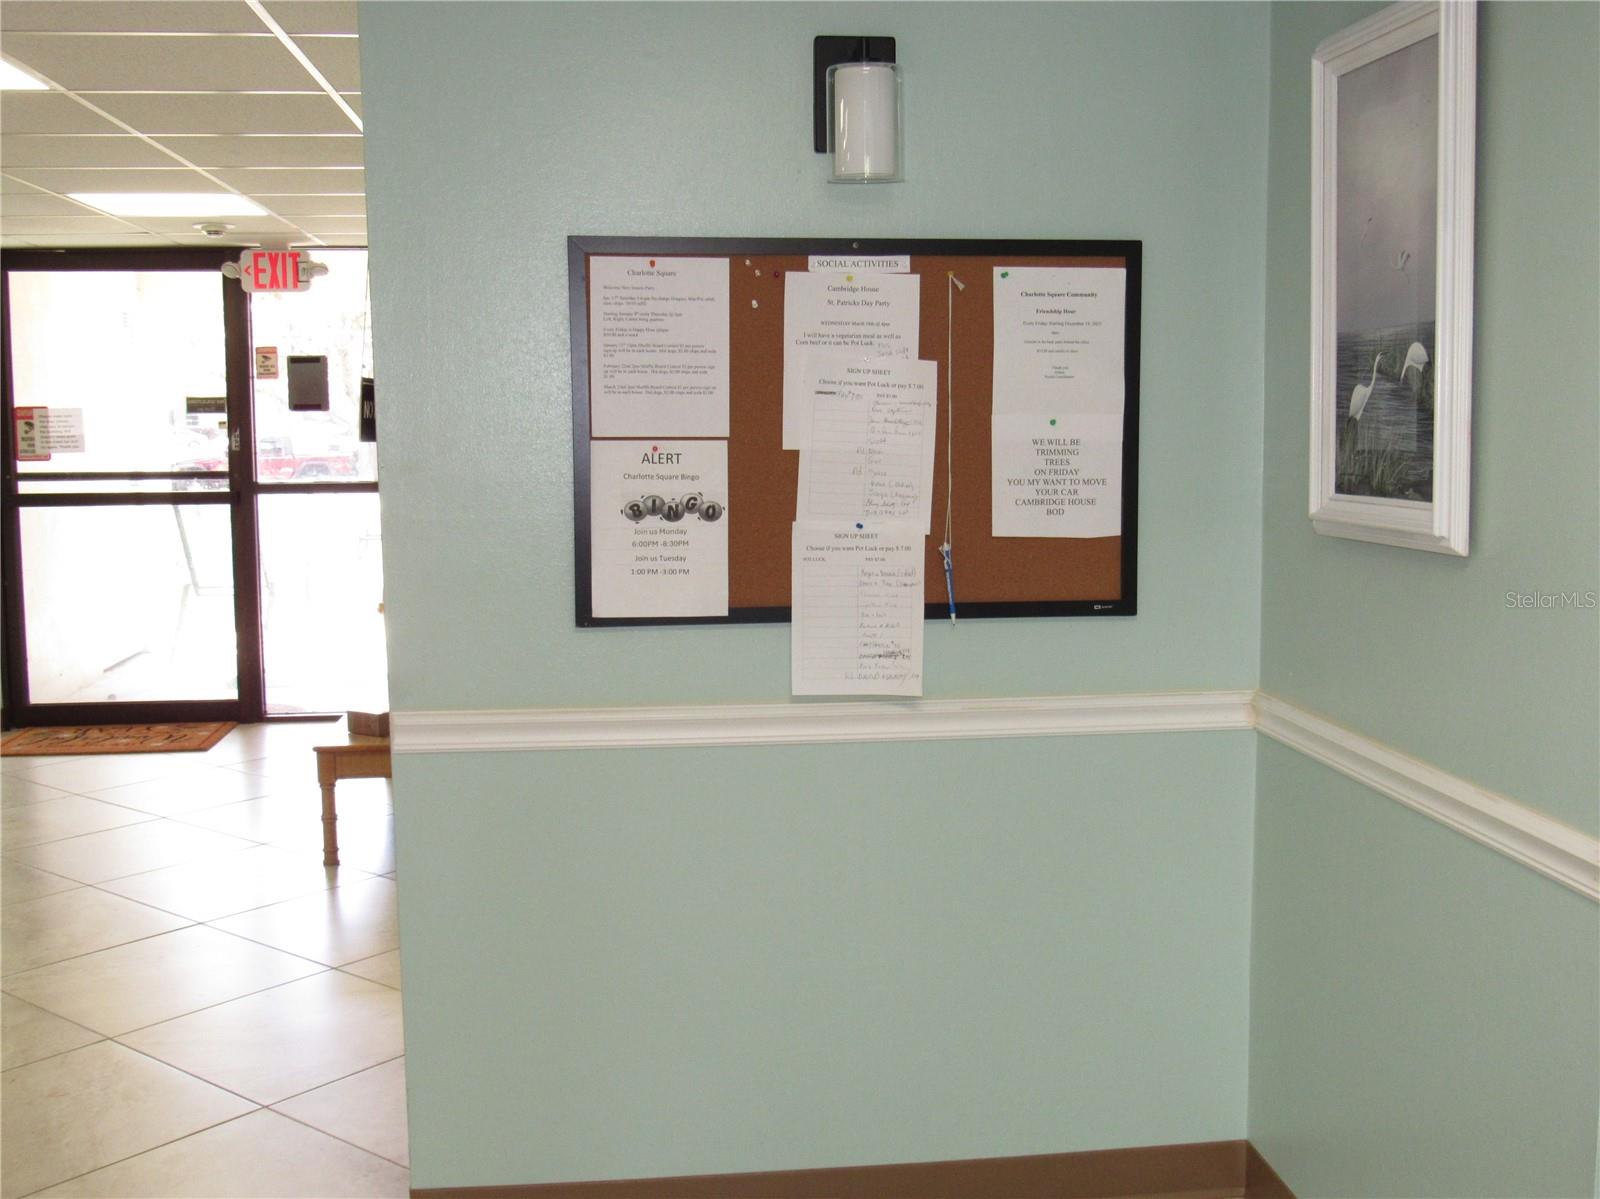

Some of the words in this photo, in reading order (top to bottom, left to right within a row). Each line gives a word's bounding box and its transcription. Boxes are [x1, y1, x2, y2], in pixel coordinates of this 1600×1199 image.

[817, 260, 848, 268] SOCIAL
[850, 260, 899, 268] ACTIVITIES
[253, 252, 301, 289] EXIT
[627, 269, 656, 277] Charlotte
[656, 269, 677, 277] Square
[827, 285, 859, 293] Cambridge
[1032, 438, 1045, 446] WE
[1047, 438, 1068, 446] WILL
[1069, 438, 1081, 446] BE
[1036, 448, 1080, 456] TRIMMING
[641, 452, 682, 465] ALERT
[1044, 458, 1071, 466] TREES
[1034, 468, 1047, 476] ON
[1048, 468, 1080, 476] FRIDAY
[656, 473, 679, 481] Square
[680, 473, 700, 481] Bingo
[1035, 488, 1059, 496] YOUR
[1060, 488, 1080, 496] CAR
[1015, 498, 1066, 506] CAMBRIDGE
[1067, 498, 1097, 506] HOUSE
[628, 496, 716, 520] BINGO
[1046, 508, 1065, 516] BOD
